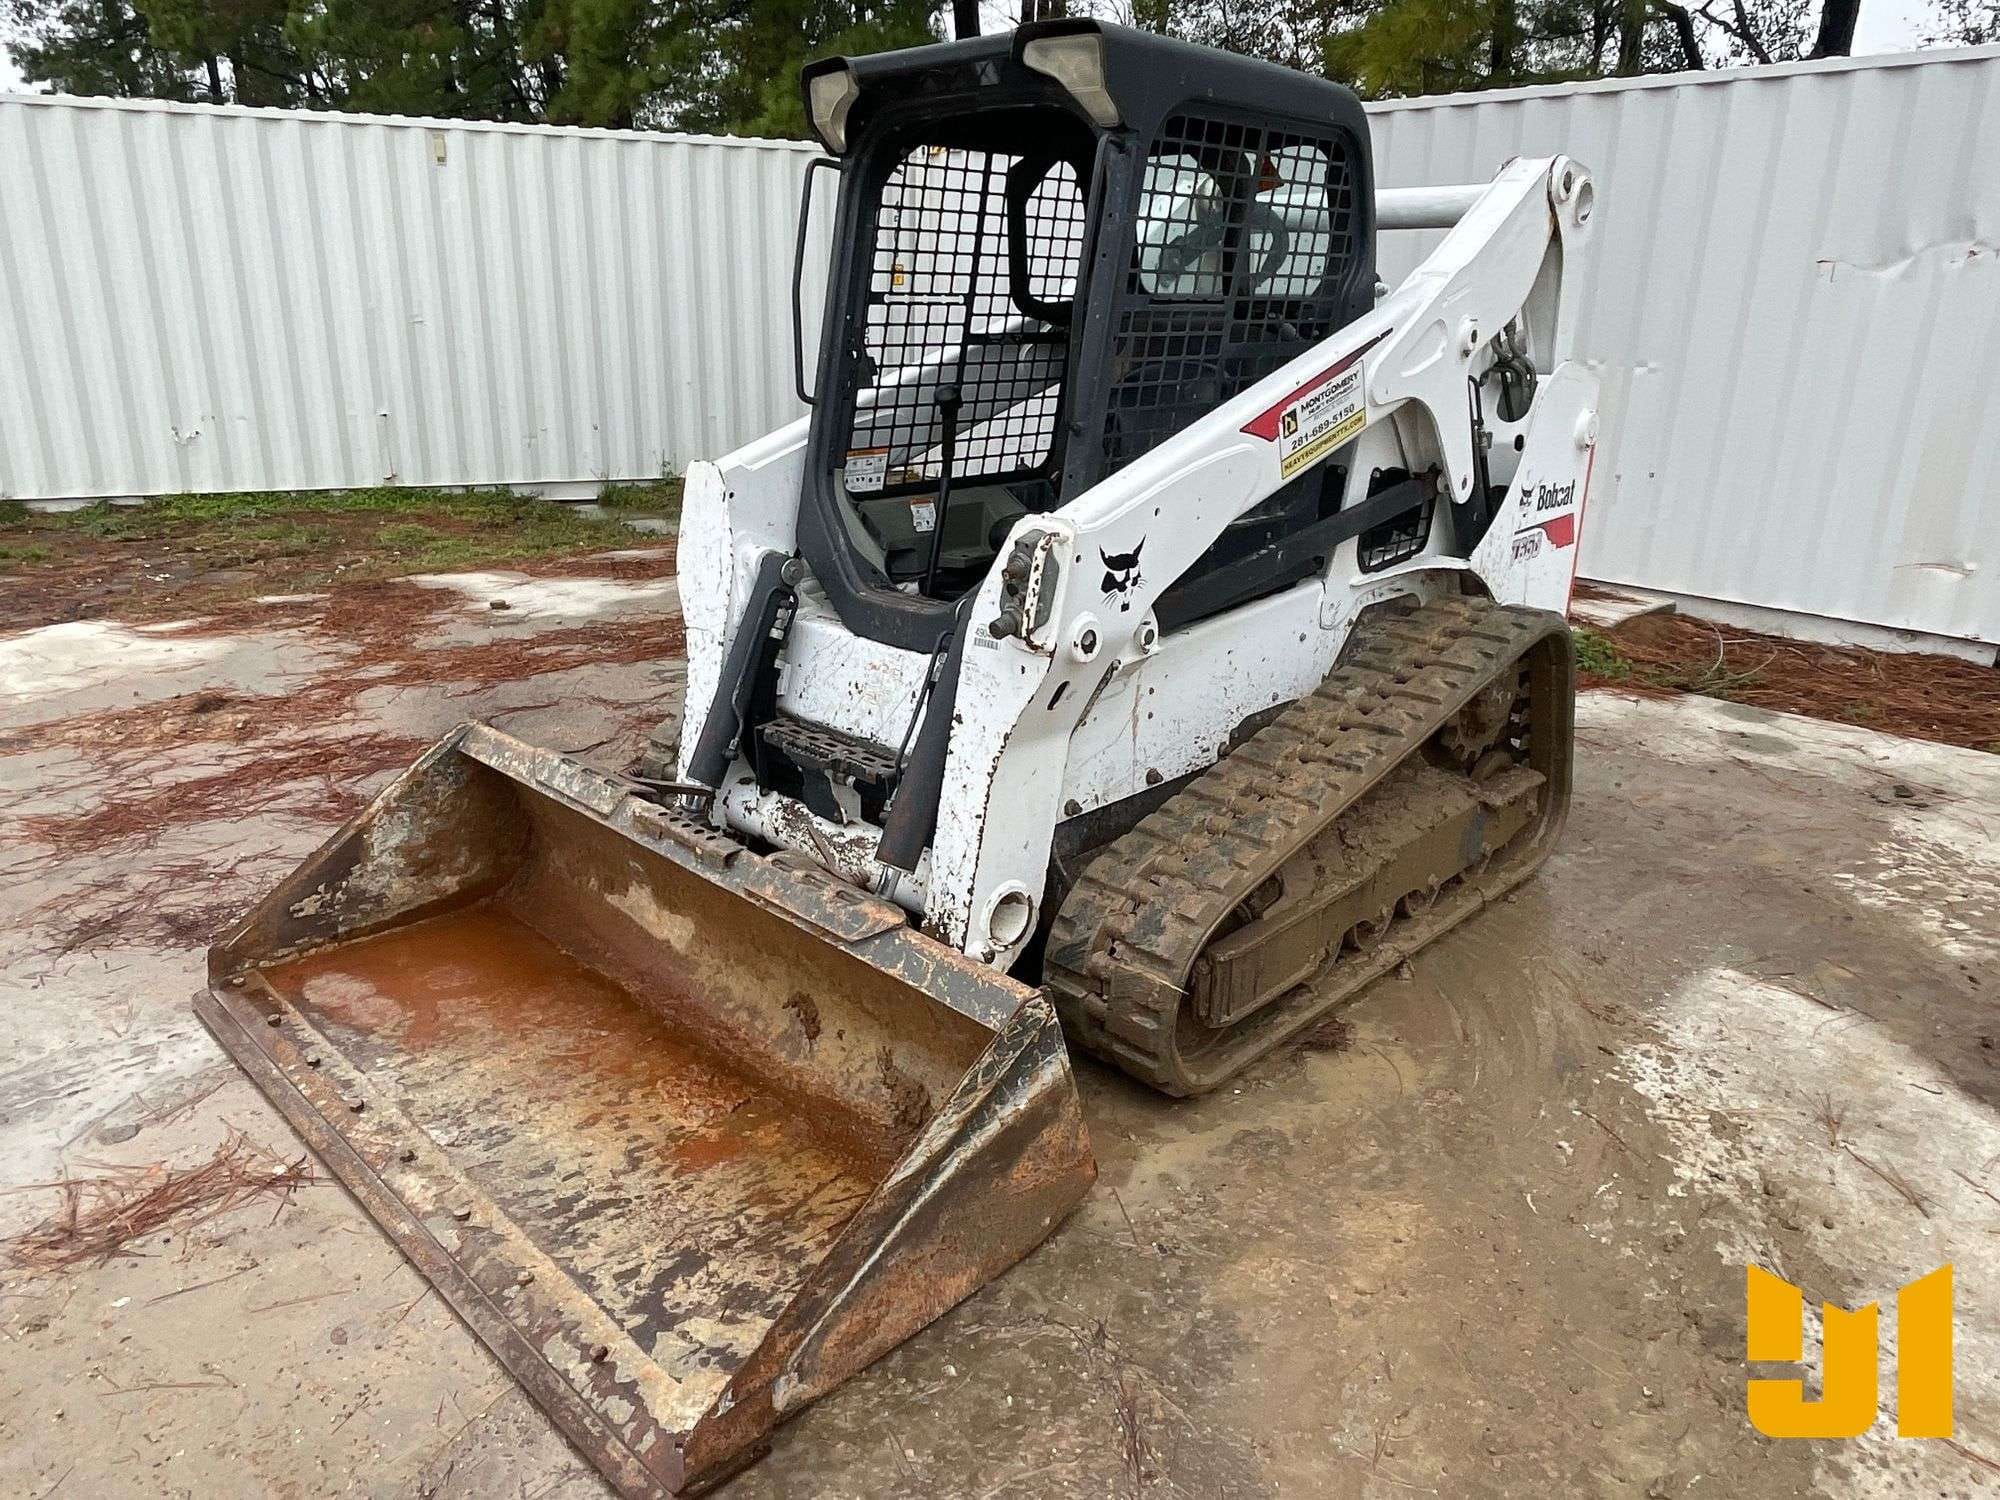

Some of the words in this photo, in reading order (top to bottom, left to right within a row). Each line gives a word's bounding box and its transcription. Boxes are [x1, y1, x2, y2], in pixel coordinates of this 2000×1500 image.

[1301, 371, 1359, 412] MONTGOMERY
[1291, 403, 1355, 450] 281-689-5150
[1537, 479, 1575, 511] Bobcat
